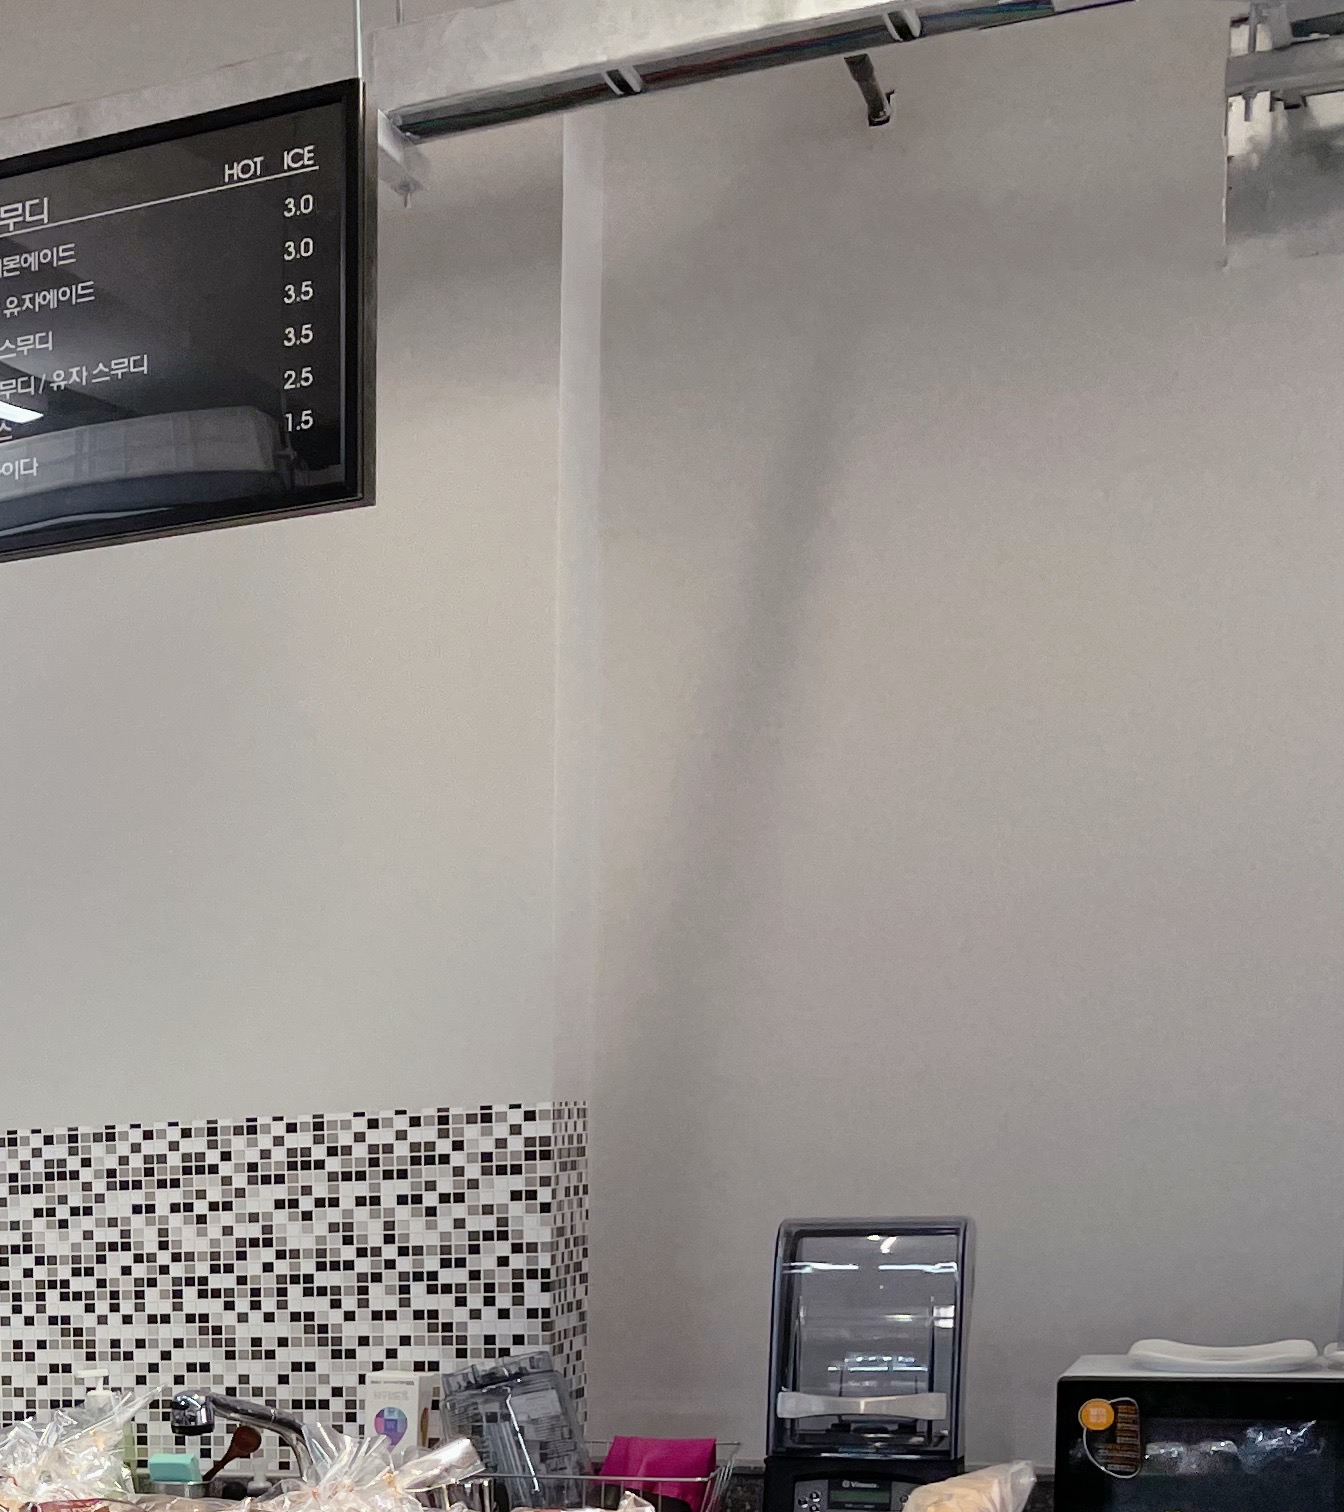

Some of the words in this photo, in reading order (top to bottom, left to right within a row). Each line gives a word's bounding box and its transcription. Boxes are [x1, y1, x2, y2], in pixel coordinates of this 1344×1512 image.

[224, 156, 264, 183] HOT
[282, 146, 315, 171] ICE
[283, 194, 314, 218] 3.0
[283, 238, 314, 261] 3.0
[4, 280, 96, 317] 유자에이드
[283, 281, 314, 304] 3.5
[283, 324, 314, 347] 3.5
[50, 365, 88, 393] 유자
[92, 354, 149, 384] 스무디
[283, 366, 314, 390] 2.5
[285, 411, 314, 433] 1.5
